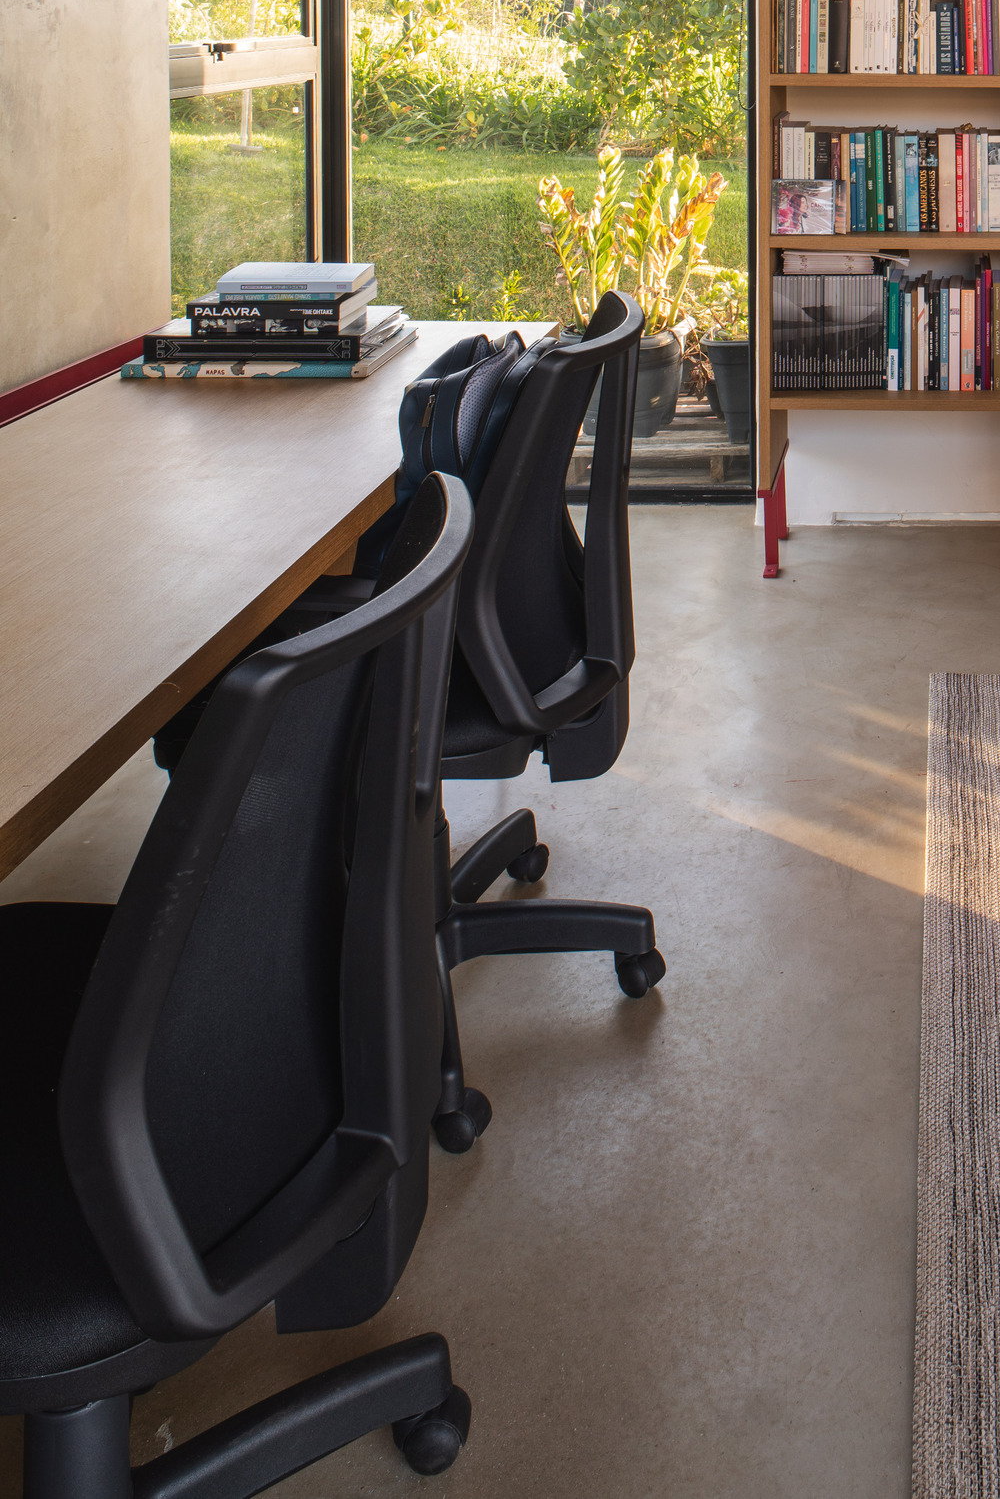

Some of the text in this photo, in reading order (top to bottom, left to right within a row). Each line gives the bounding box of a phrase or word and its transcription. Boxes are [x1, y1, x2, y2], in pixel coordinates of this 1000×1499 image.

[940, 11, 951, 63] OS LUSÍADAS
[929, 170, 937, 222] OS JAPONESES
[194, 307, 261, 317] PALAVRA
